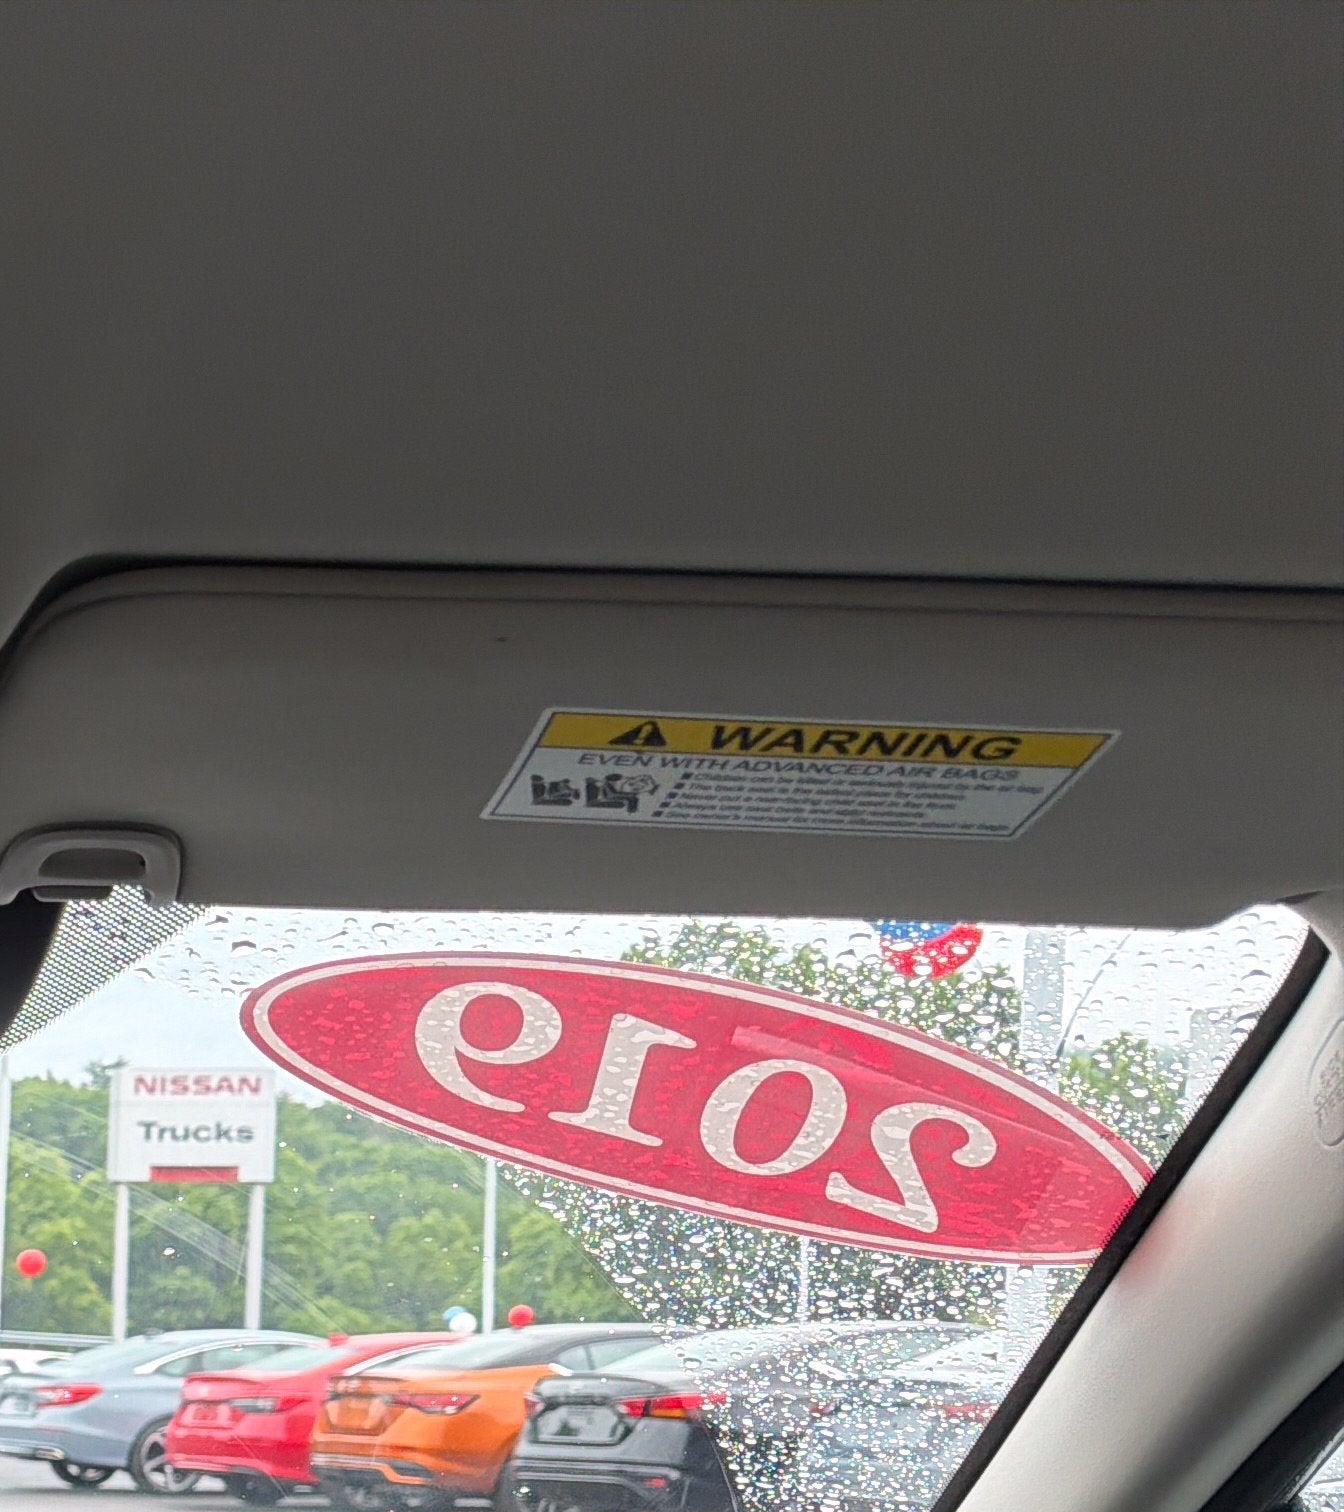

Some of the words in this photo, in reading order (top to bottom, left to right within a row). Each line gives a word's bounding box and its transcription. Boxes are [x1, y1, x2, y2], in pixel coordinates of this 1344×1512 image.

[711, 724, 1024, 761] WARNING
[577, 753, 654, 766] EVEN
[657, 756, 731, 769] WITH
[731, 759, 887, 776] ADVANCED
[885, 765, 939, 778] AIR
[938, 768, 1022, 781] BAGS
[134, 1075, 262, 1096] NISSAN
[137, 1120, 254, 1143] Trucks
